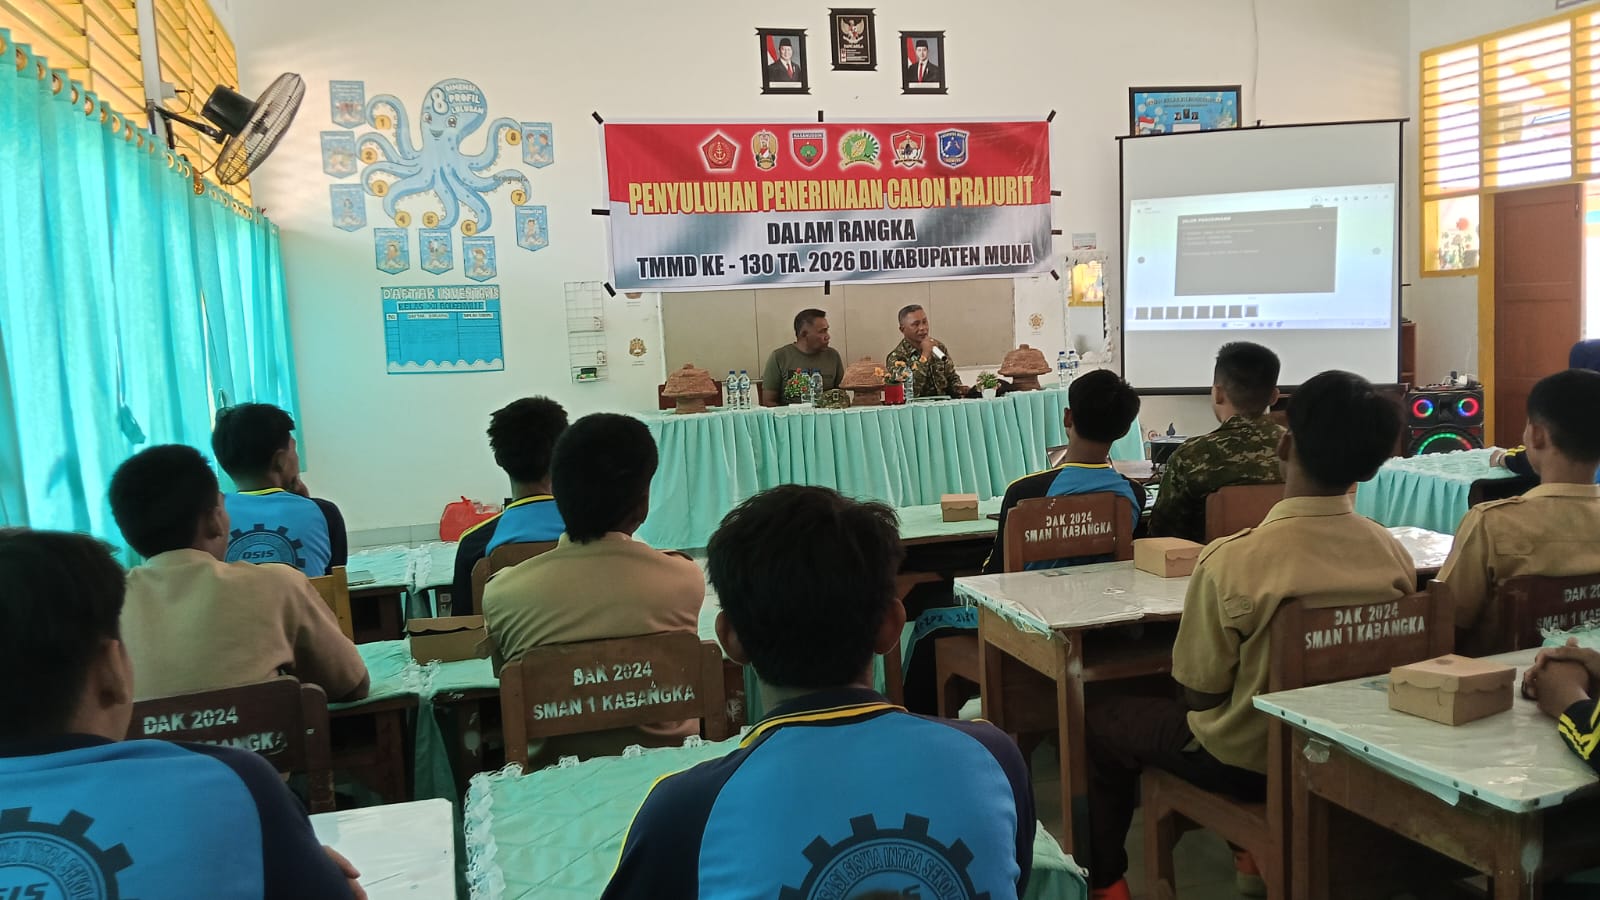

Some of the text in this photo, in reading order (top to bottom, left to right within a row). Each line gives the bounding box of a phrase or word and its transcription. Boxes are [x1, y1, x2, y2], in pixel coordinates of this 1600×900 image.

[431, 88, 449, 114] 8
[448, 93, 481, 104] PROFIL
[516, 192, 523, 201] 7
[628, 175, 1034, 214] PENYULUHAN PENERIMAAN CALON PRAJURIT
[767, 218, 916, 245] DALAM RANGKA
[636, 255, 697, 278] TMMD
[702, 255, 725, 276] KE
[739, 253, 774, 275] 130
[777, 252, 805, 273] TA.
[809, 250, 855, 272] 2026
[859, 249, 878, 270] DI
[882, 246, 980, 270] KABUPATEN
[984, 244, 1034, 265] MUNA
[383, 287, 435, 300] DAFTAR
[1046, 511, 1093, 527] DAK 2024
[1024, 522, 1112, 542] SMAN 1 KABANGKA
[242, 549, 275, 560] OSIS
[1335, 602, 1399, 625] DAK 2024
[1305, 615, 1425, 650] SMAN 1 KABANGKA
[573, 661, 653, 686] DAK 2024
[533, 684, 696, 720] SMAN 1 KABANGKA
[143, 705, 239, 735] DAK 2024
[883, 846, 923, 872] INTRA
